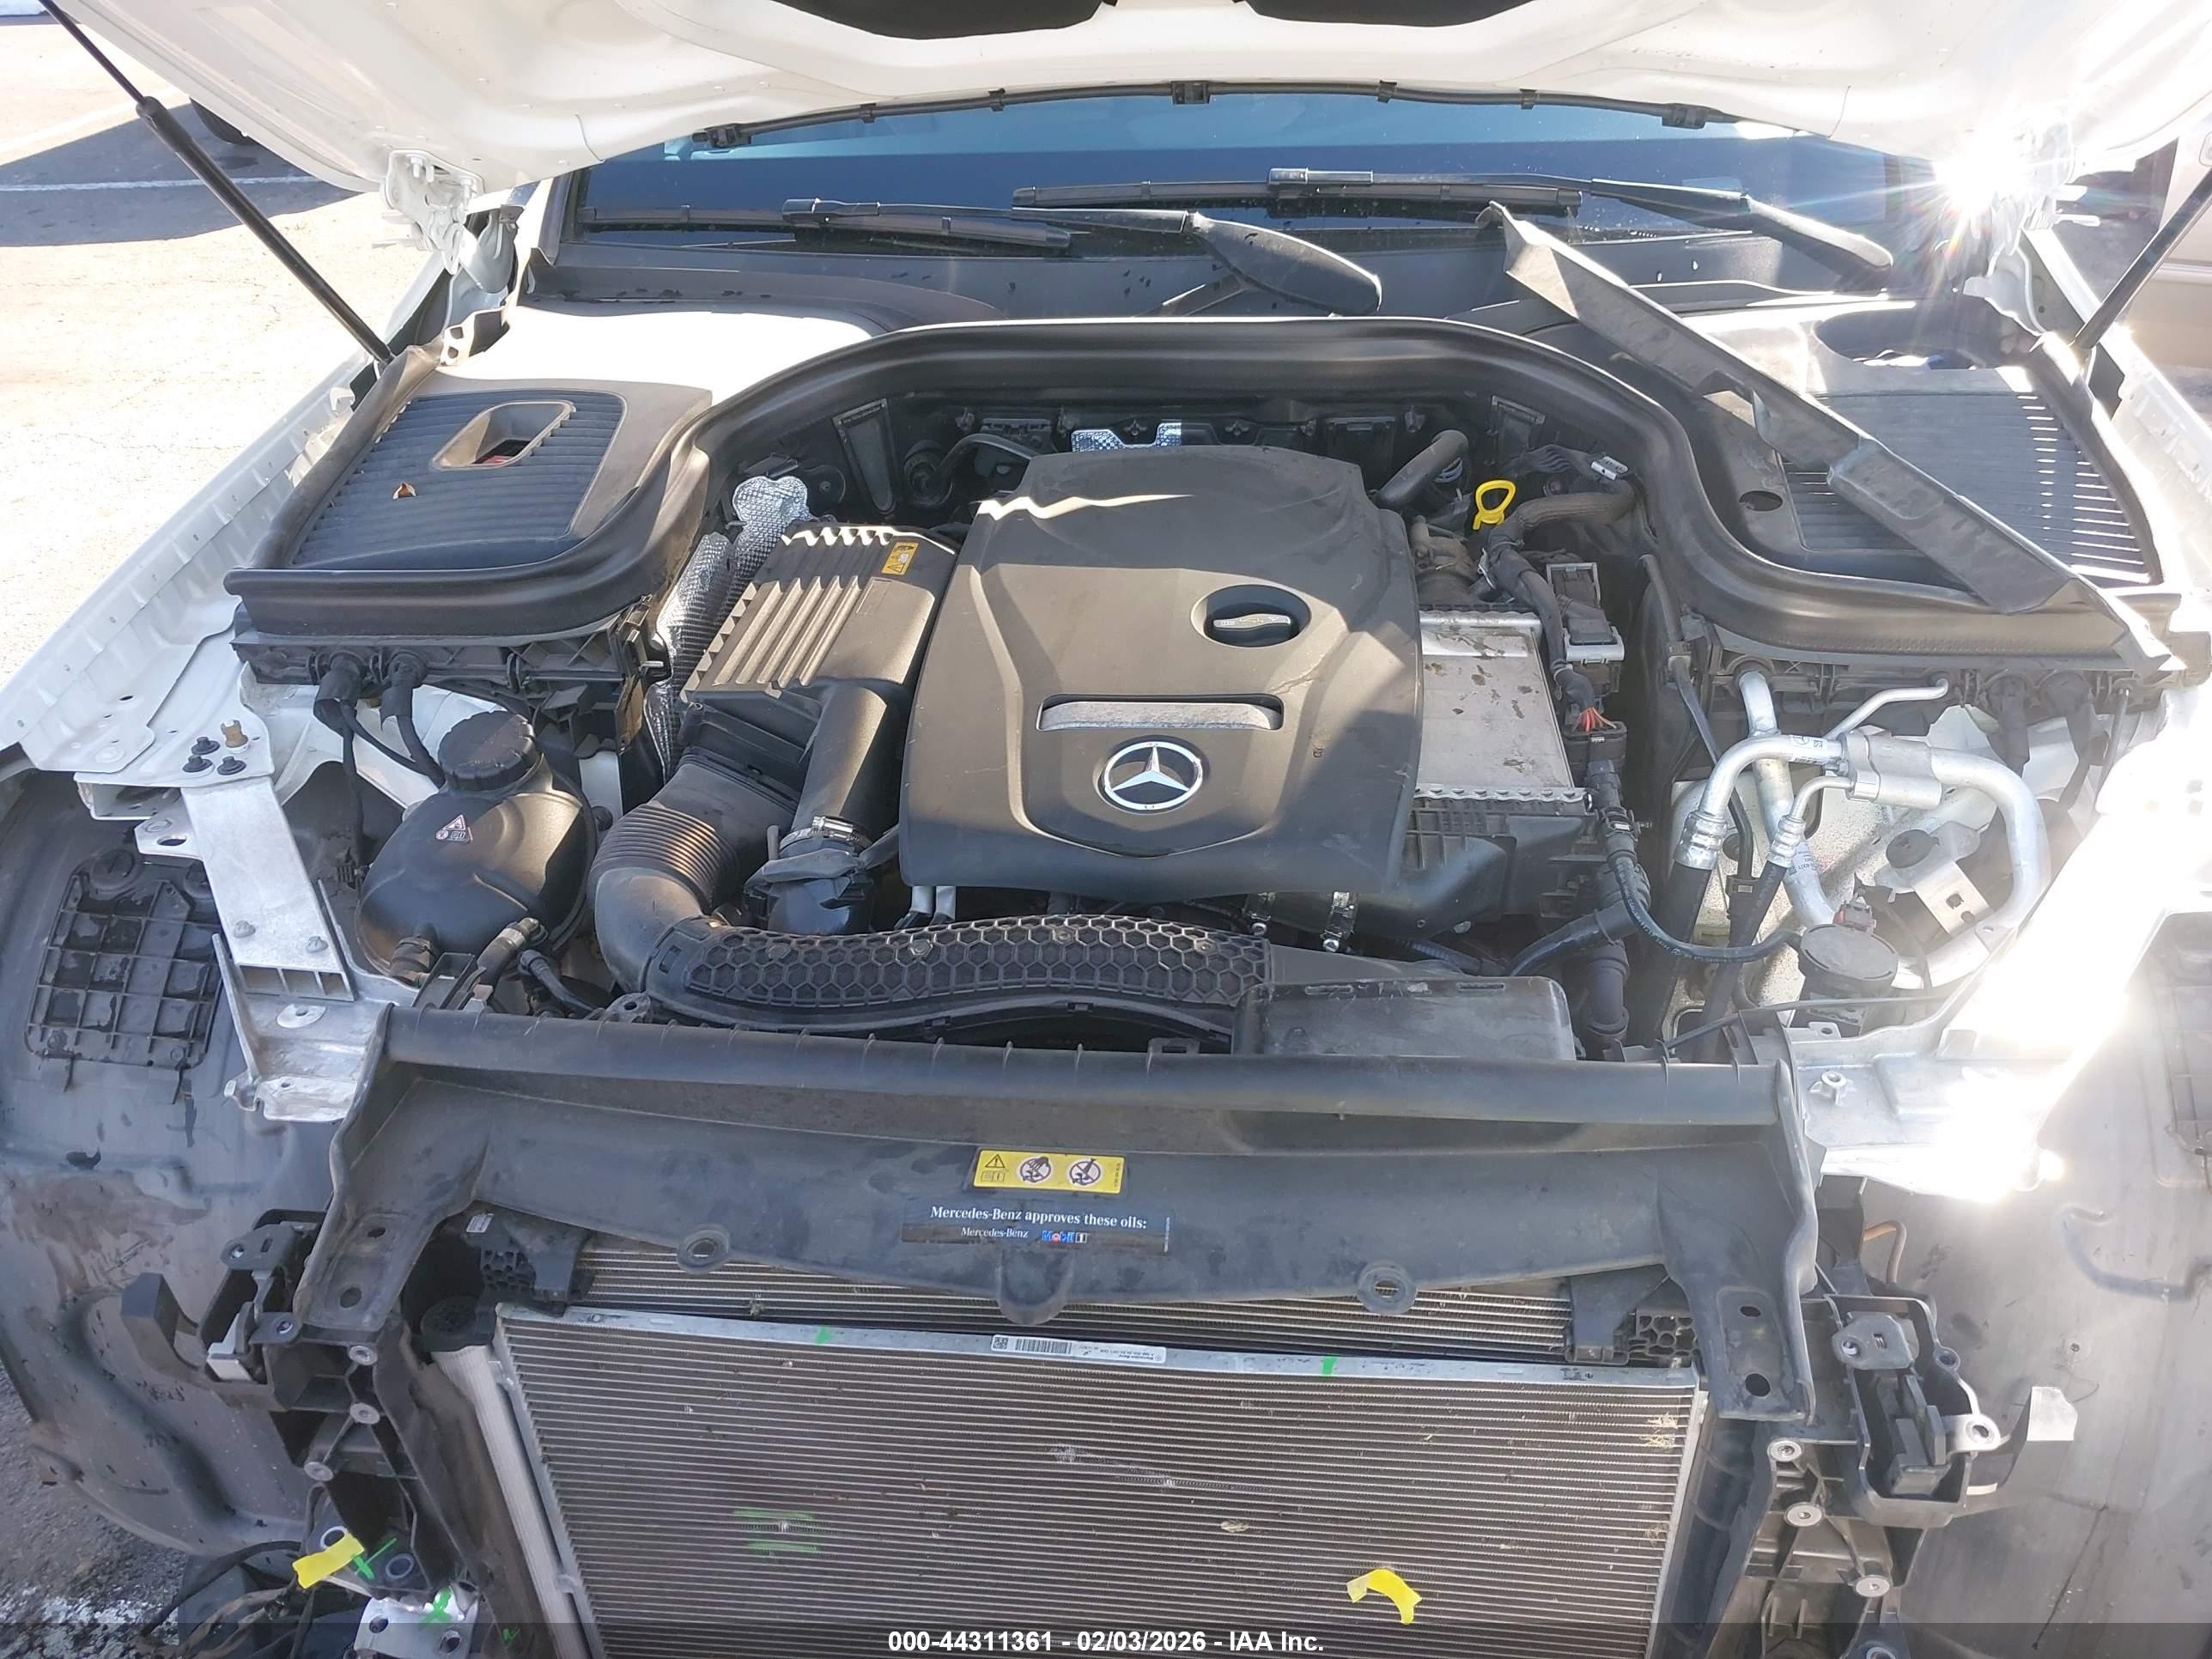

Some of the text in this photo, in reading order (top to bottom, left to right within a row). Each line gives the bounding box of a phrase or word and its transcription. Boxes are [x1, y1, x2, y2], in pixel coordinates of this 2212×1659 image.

[930, 1206, 1147, 1230] Mercedes-Benz approves these oils:
[961, 1226, 1030, 1238] Mercedes-Benz
[1042, 1230, 1074, 1243] Mobil
